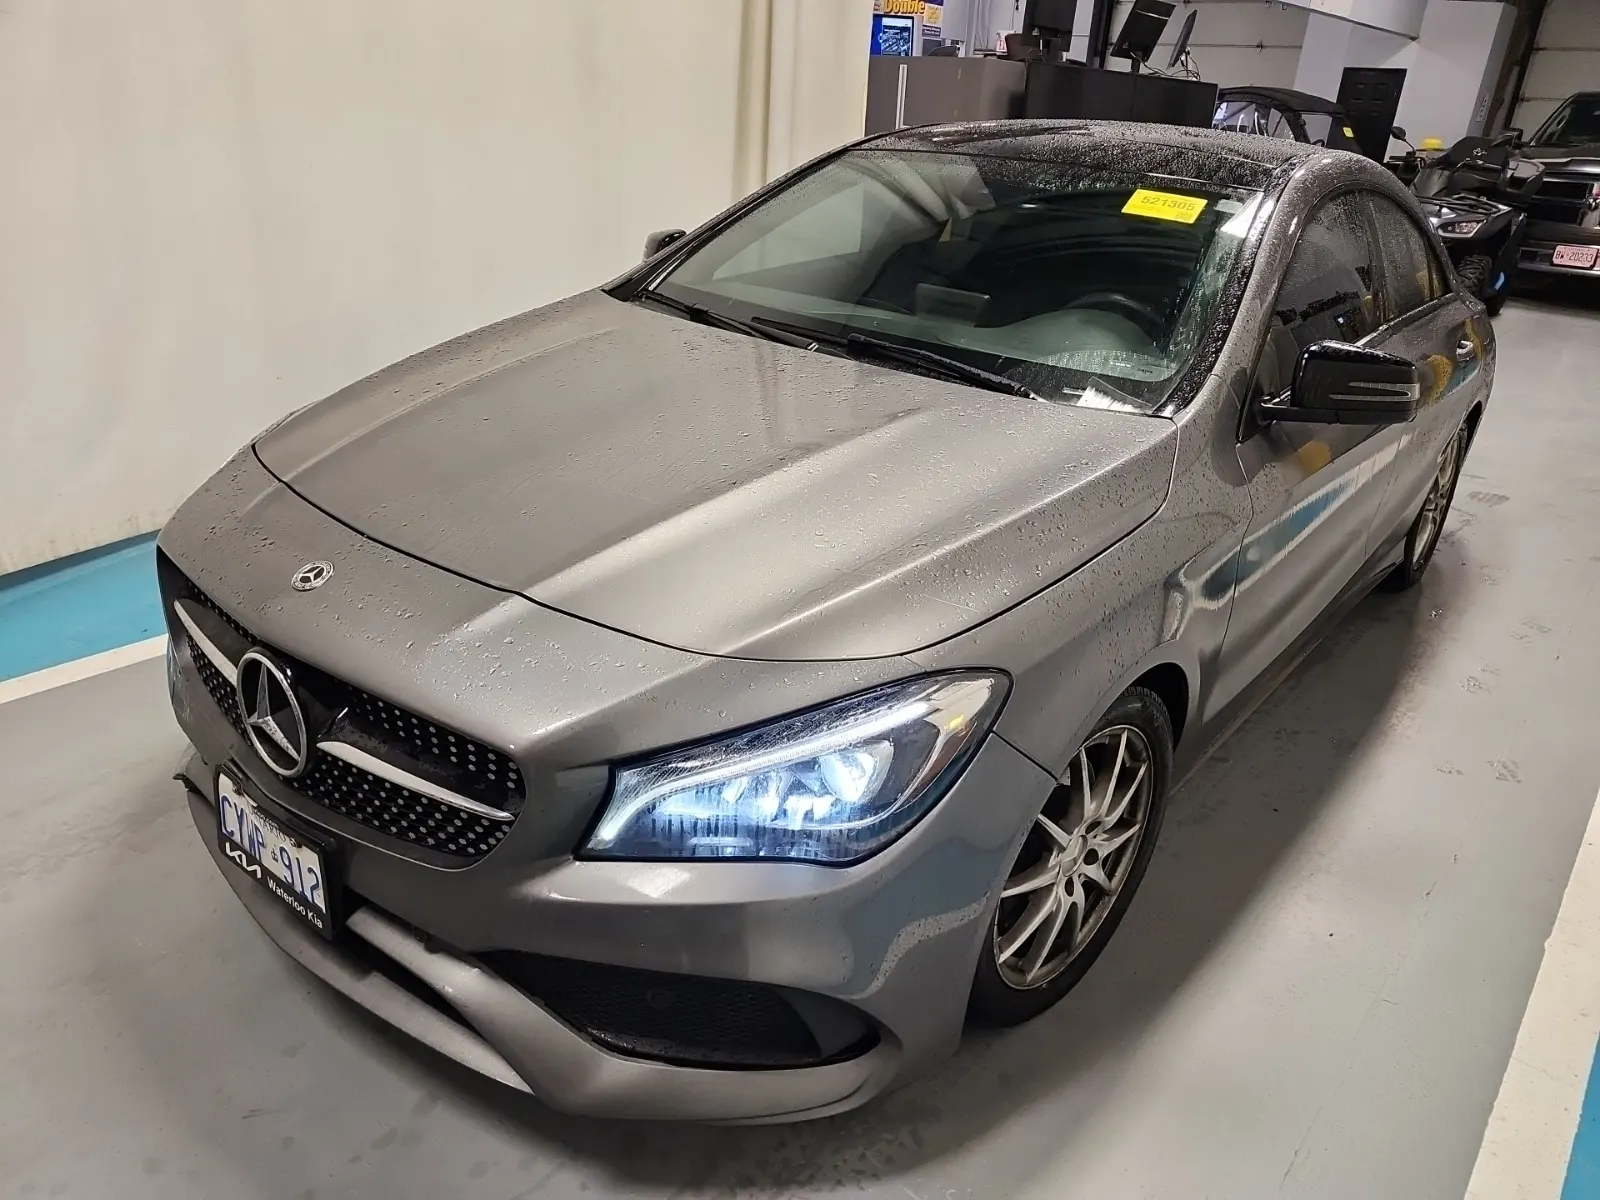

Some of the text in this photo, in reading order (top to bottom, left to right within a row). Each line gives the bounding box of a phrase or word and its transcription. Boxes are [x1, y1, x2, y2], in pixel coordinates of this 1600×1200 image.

[884, 0, 926, 14] Double
[1141, 196, 1196, 211] 521305
[221, 795, 320, 903] CYWP 912
[267, 876, 323, 929] Waterloo Kia
